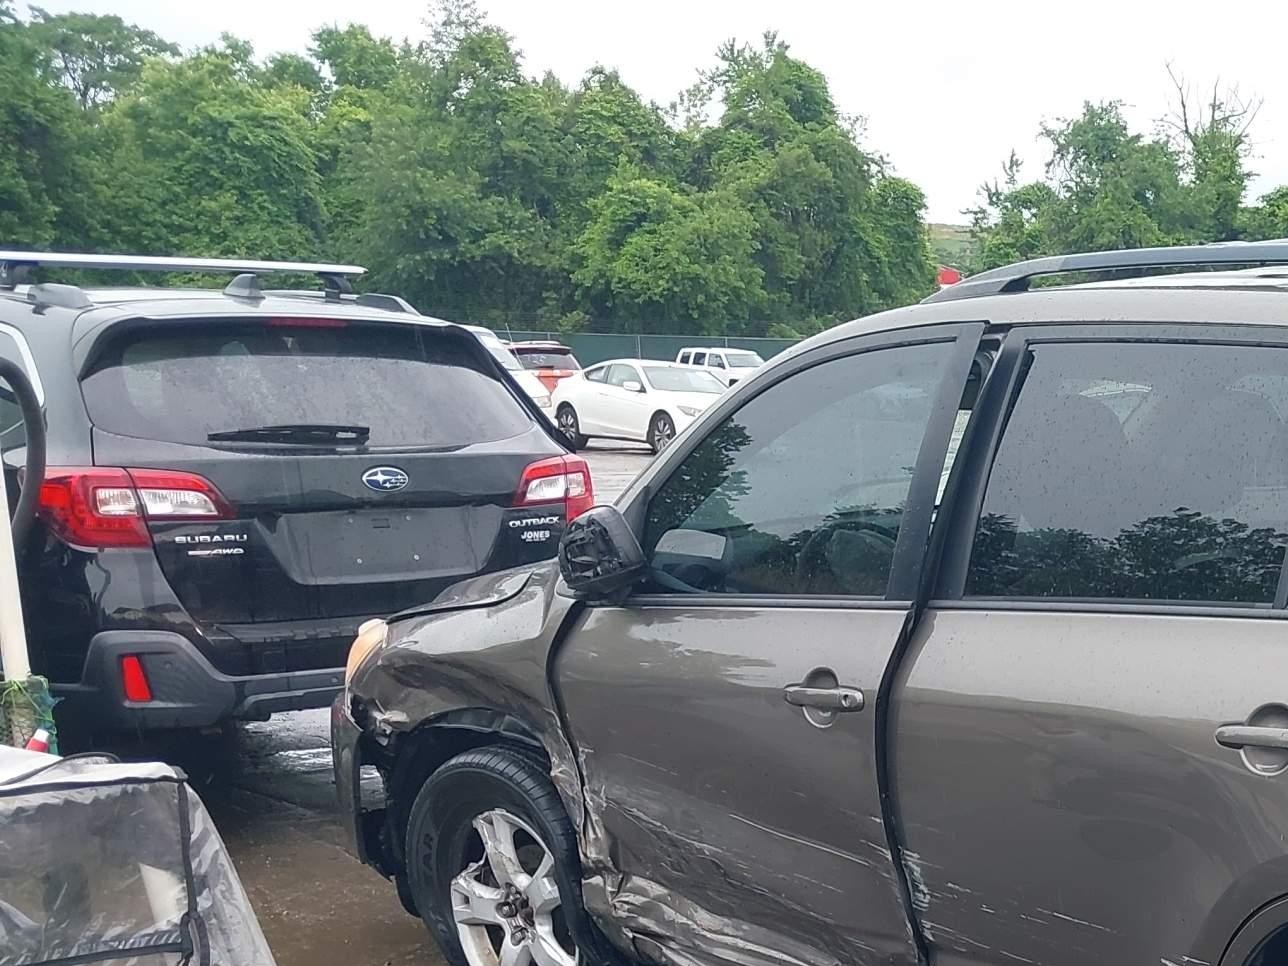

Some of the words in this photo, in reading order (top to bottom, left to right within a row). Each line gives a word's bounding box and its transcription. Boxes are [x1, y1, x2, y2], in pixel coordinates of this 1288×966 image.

[508, 516, 560, 528] OUTBACK
[174, 534, 248, 544] SUBARU
[520, 530, 550, 540] JONES
